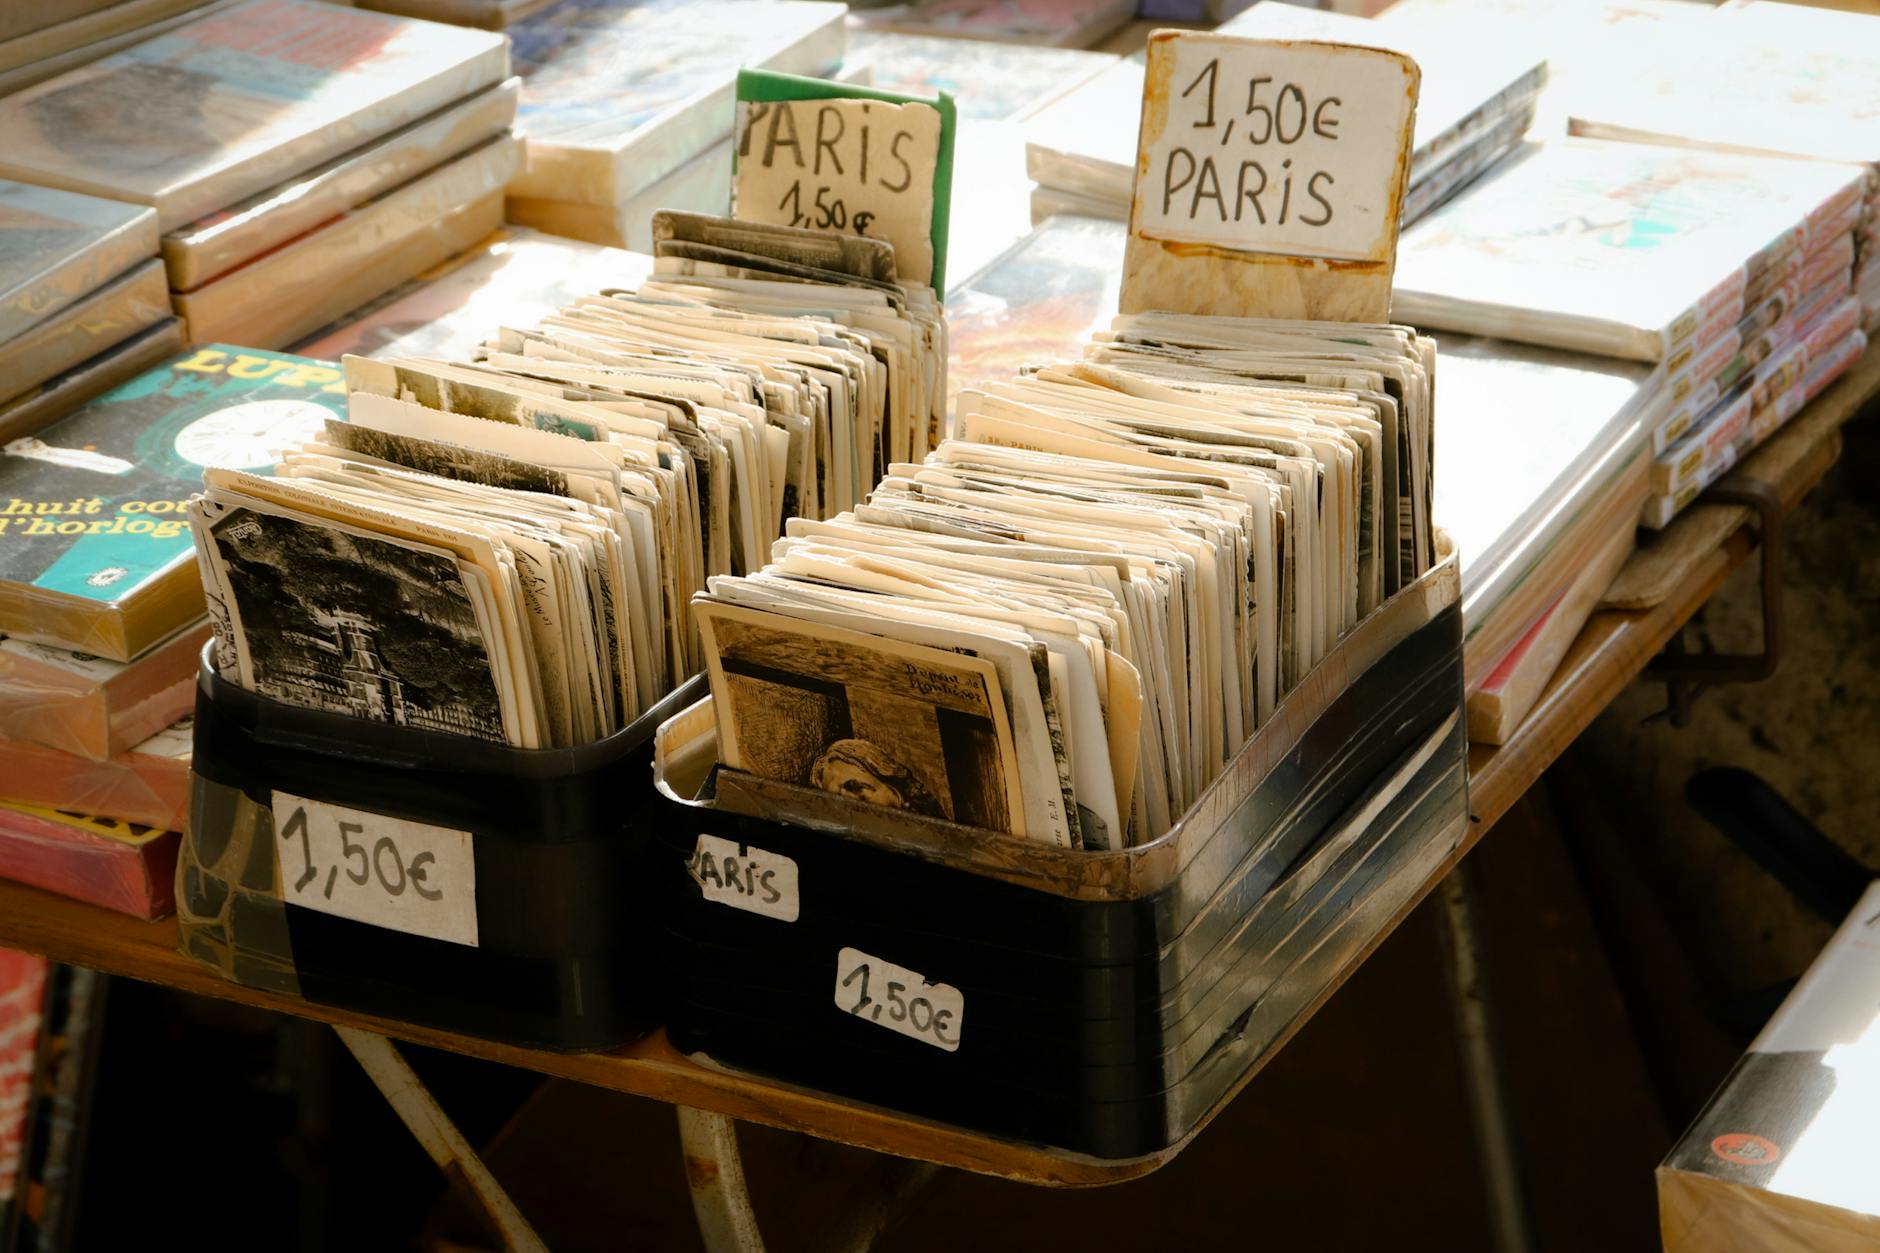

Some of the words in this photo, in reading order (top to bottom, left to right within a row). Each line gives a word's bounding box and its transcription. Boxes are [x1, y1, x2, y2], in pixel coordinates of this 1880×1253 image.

[1182, 58, 1342, 146] 1,50€
[779, 179, 876, 237] 1,50€
[0, 498, 104, 515] huit
[281, 806, 443, 900] 1,50€
[842, 964, 960, 1045] 1,50€
